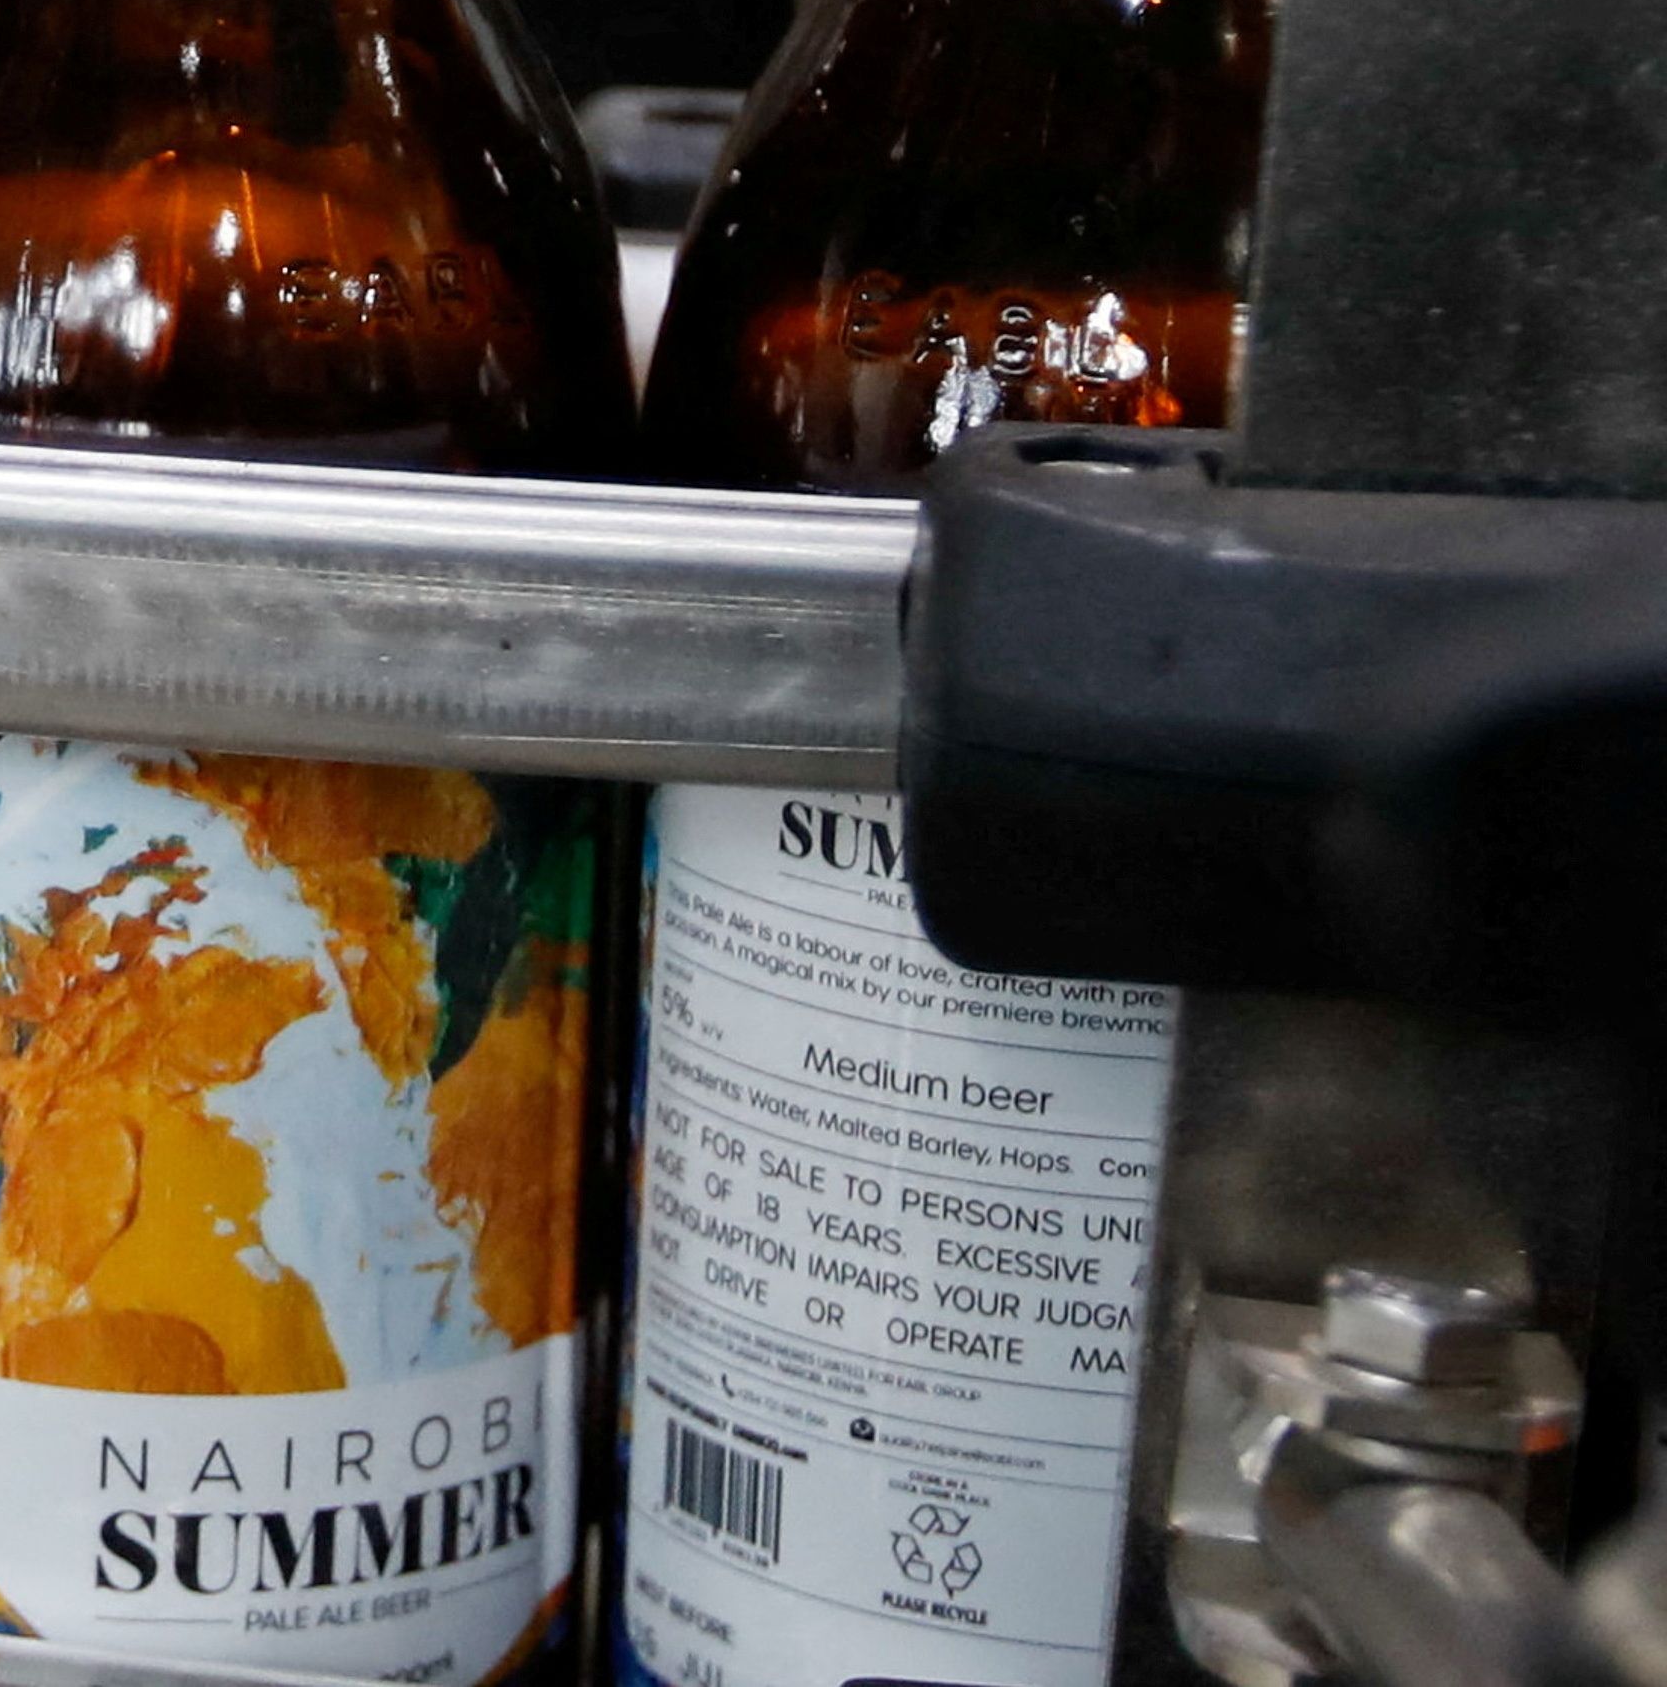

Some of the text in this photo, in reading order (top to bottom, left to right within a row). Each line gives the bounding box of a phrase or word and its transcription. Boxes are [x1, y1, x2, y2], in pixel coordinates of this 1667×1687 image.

[722, 936, 736, 957] A
[737, 943, 815, 982] magical
[819, 969, 857, 993] mix
[862, 977, 892, 1006] by
[897, 987, 937, 1009] our
[943, 996, 1055, 1027] premiere
[728, 911, 754, 936] Ale
[758, 920, 772, 943] is
[777, 930, 791, 947] a
[796, 930, 863, 966] labour
[869, 952, 894, 973] of
[898, 958, 953, 988] love,
[960, 971, 1053, 1000] crafted
[1060, 982, 1116, 1005] with
[748, 1086, 812, 1129] Water,
[817, 1109, 902, 1148] Malted
[908, 1131, 992, 1165] Barley,
[803, 1043, 1055, 1115] Medium beer
[700, 1124, 747, 1166] FOR
[759, 1150, 827, 1195] SALE
[843, 1173, 883, 1208] TO
[901, 1187, 1065, 1238] PERSONS
[704, 1171, 734, 1204] OF
[755, 1191, 782, 1224] 18
[806, 1207, 907, 1258] YEARS.
[937, 1238, 1102, 1287] EXCESSIVE
[651, 1184, 797, 1273] CONSUMPTION
[808, 1253, 920, 1304] IMPAIRS
[933, 1283, 1022, 1320] YOUR
[704, 1258, 770, 1307] DRIVE
[804, 1296, 846, 1331] OR
[886, 1317, 1025, 1366] OPERATE
[100, 1380, 544, 1492] NAIROBI
[96, 1465, 536, 1594] SUMMER
[244, 1604, 310, 1632] PALE
[317, 1598, 365, 1626] ALE
[882, 1590, 929, 1615] PLEASE
